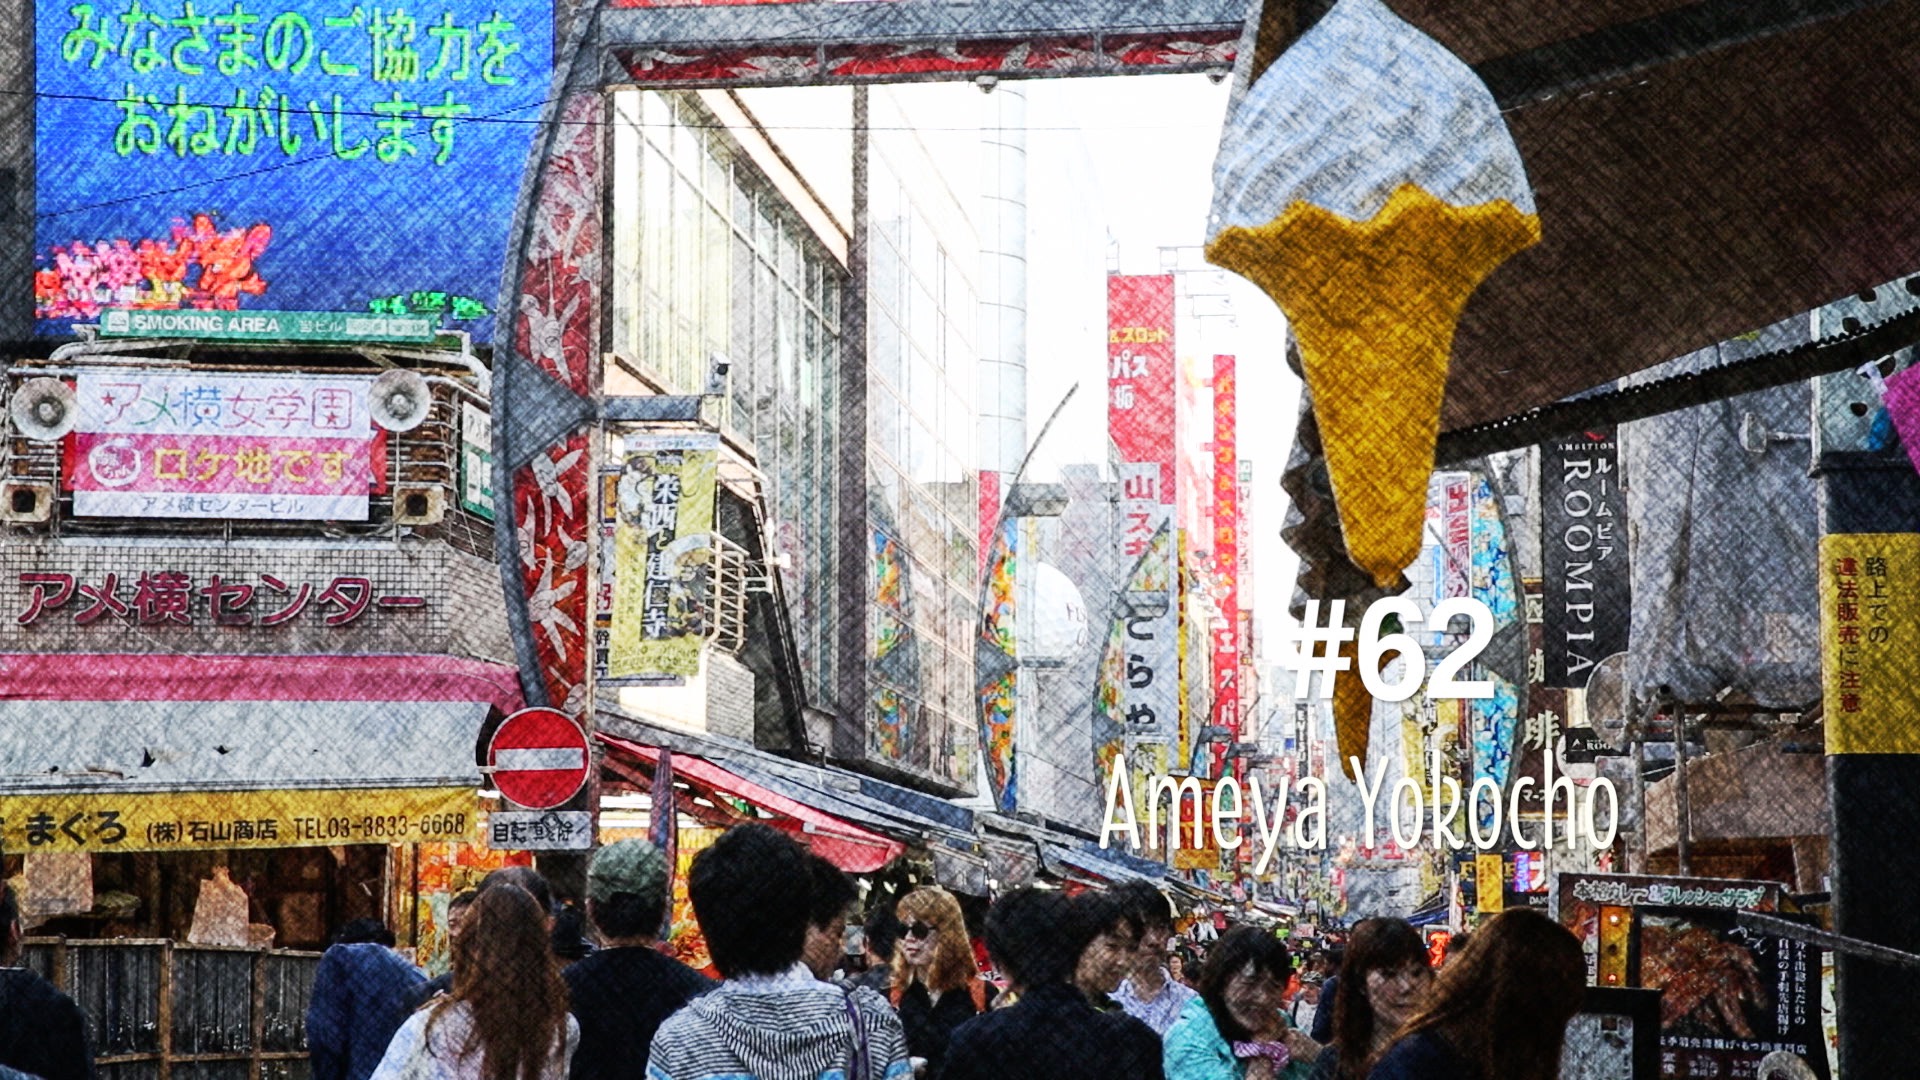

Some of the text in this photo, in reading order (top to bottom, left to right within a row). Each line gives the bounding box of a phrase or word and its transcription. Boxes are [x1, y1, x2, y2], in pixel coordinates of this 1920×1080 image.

[60, 3, 521, 85] みなさまのご協力を
[114, 83, 471, 165] おねがいします
[134, 314, 280, 333] SMOKING AREA
[98, 382, 354, 432] アメ横女学園
[152, 446, 353, 484] ロケ地です
[140, 496, 304, 516] アメ横センタービル
[1594, 458, 1613, 561] ルームピア
[18, 572, 427, 627] アメ横センター
[1563, 458, 1595, 678] ROOMPIA
[1865, 557, 1889, 644] 路上での
[1836, 557, 1861, 713] 違法販売に注意
[25, 811, 127, 846] まぐろ
[146, 819, 278, 843] (株)石山商店
[294, 813, 466, 840] TEL03-3833-6668
